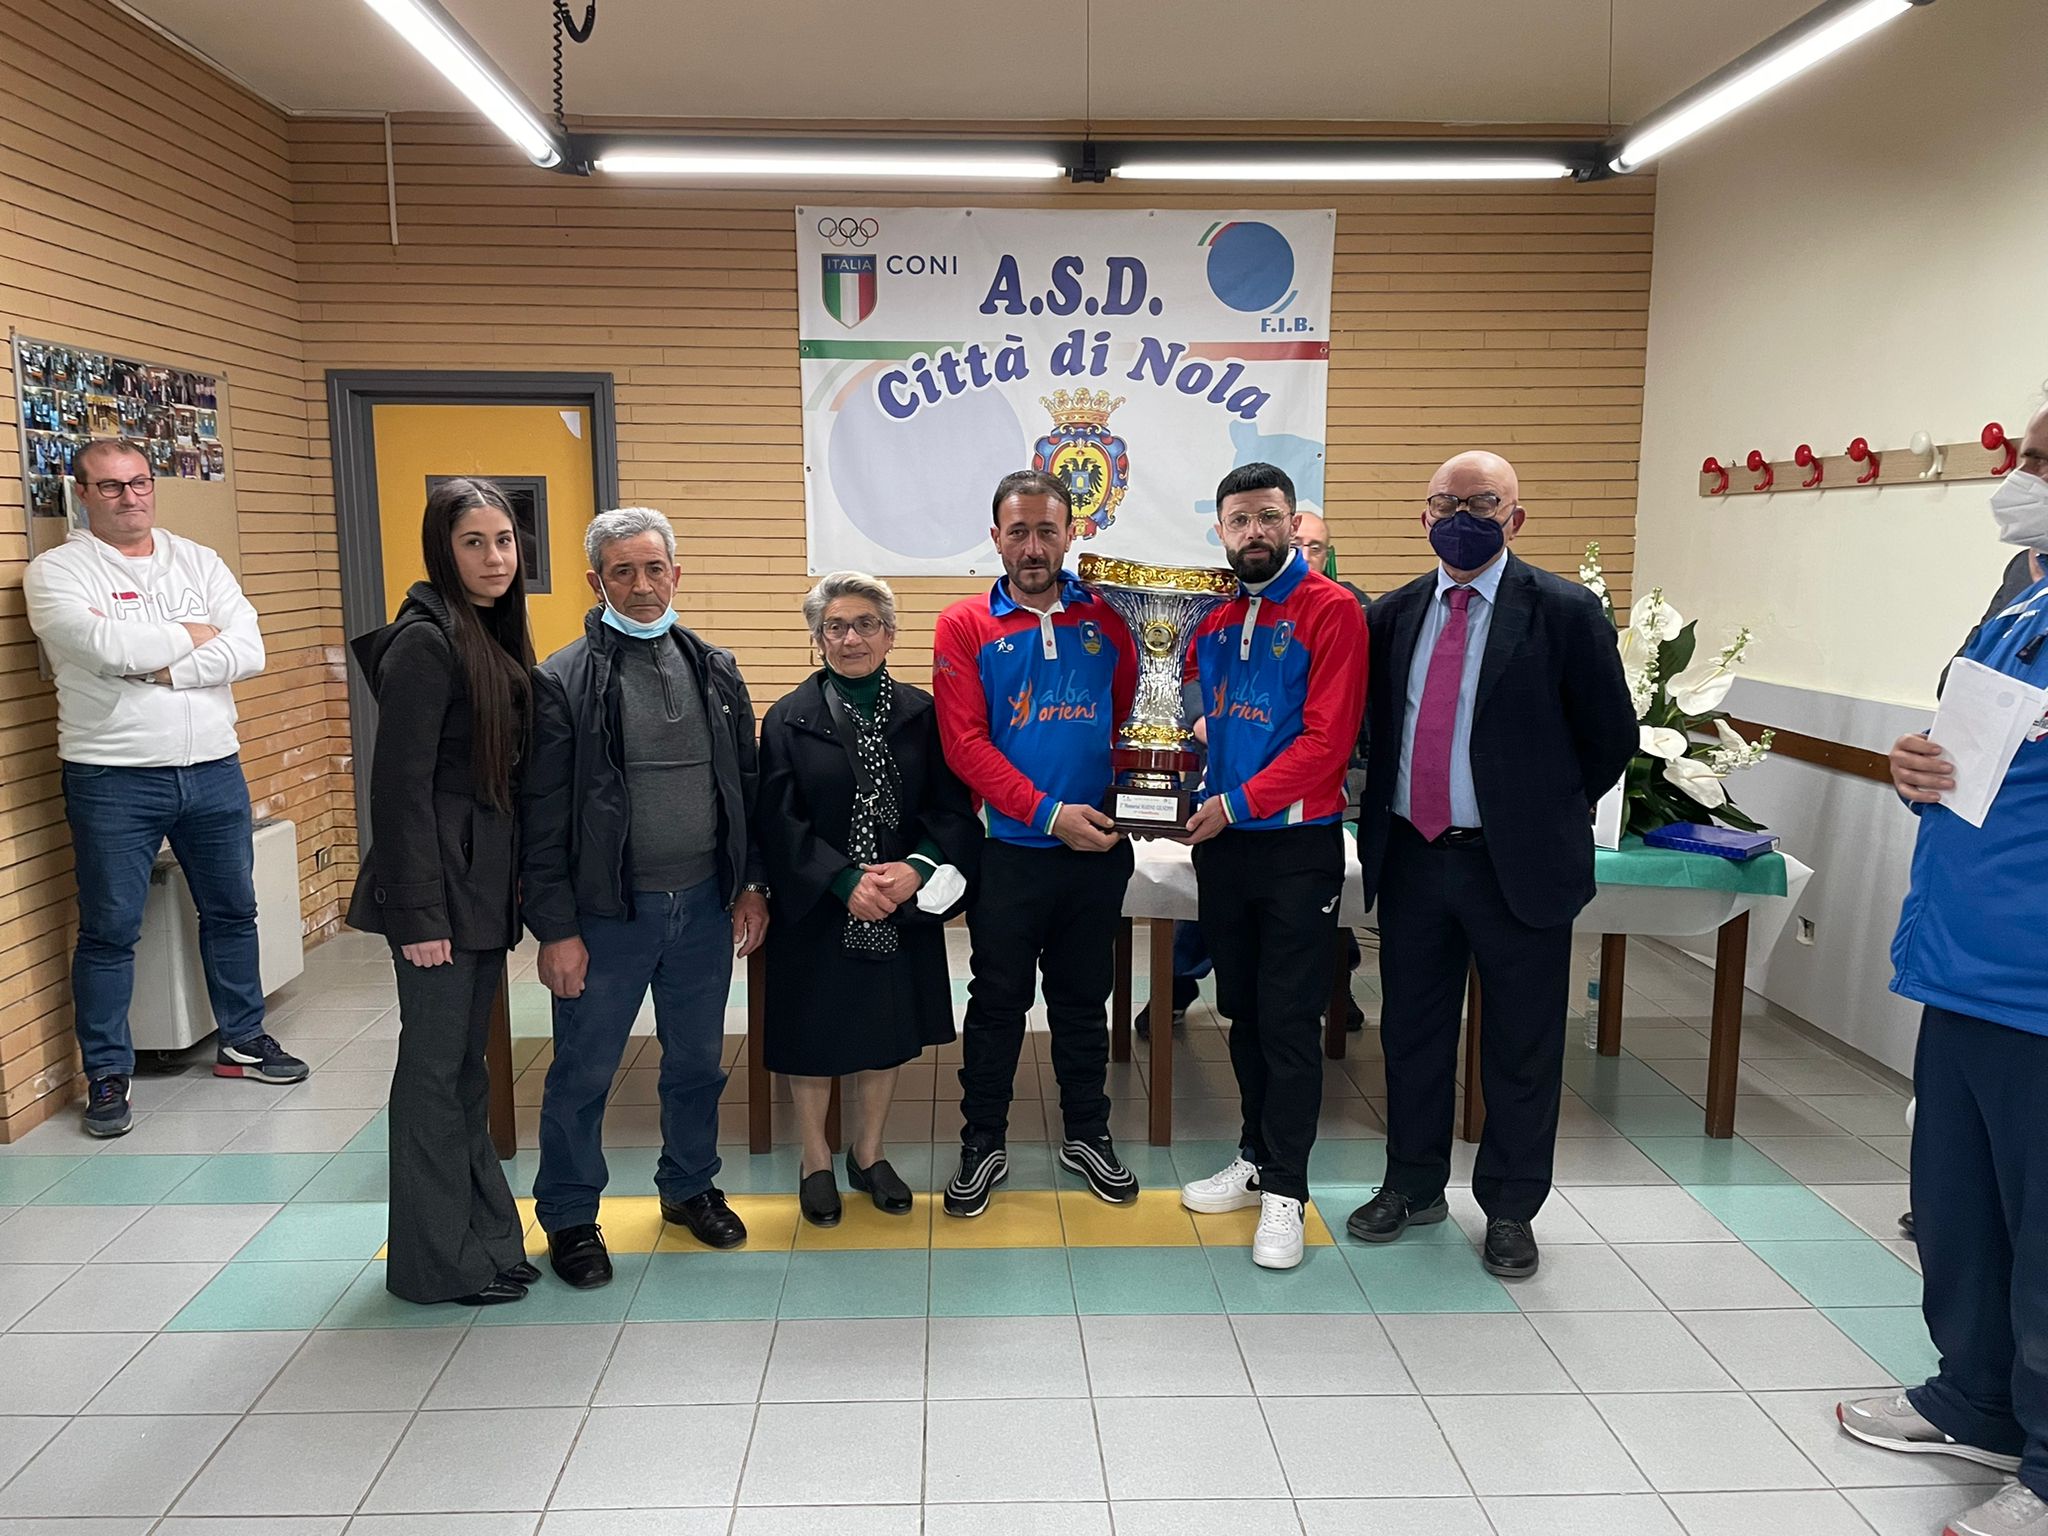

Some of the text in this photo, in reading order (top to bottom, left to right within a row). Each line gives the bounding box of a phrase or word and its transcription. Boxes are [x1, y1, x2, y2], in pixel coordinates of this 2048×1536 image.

[827, 259, 872, 270] ITALIA
[886, 255, 957, 275] CONI
[979, 254, 1163, 316] A.S.D.
[1261, 317, 1314, 333] F.I.B.
[878, 329, 1271, 419] Città di Nola
[112, 587, 209, 621] FILA
[1039, 668, 1092, 704] alba
[1038, 701, 1097, 722] oriens
